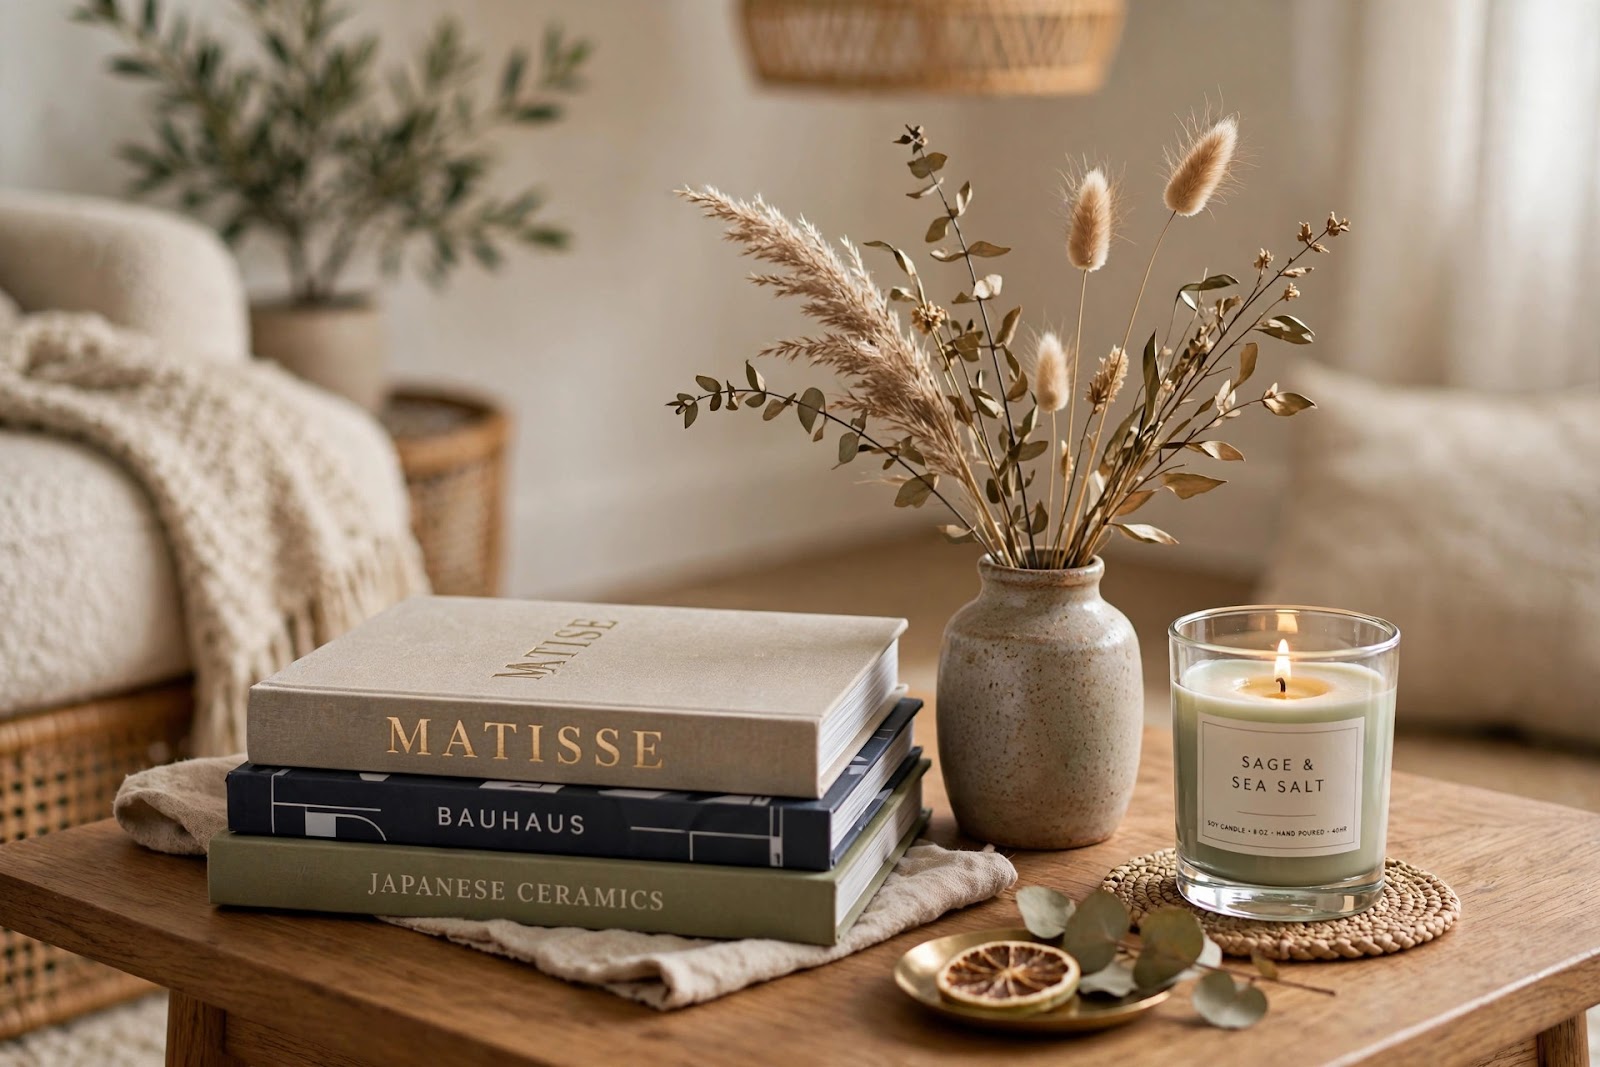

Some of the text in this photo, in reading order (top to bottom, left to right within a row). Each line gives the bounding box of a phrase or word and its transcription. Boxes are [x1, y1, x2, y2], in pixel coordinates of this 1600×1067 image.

[386, 716, 664, 769] MATISSE
[1241, 755, 1314, 771] SAGE &
[1232, 776, 1325, 793] SEA SALT
[437, 806, 585, 835] BAUHAUS
[1207, 820, 1219, 828] SOY
[1220, 823, 1246, 834] CANDLE
[1298, 829, 1325, 837] POURED
[367, 872, 664, 911] JAPANESE CERAMICS
